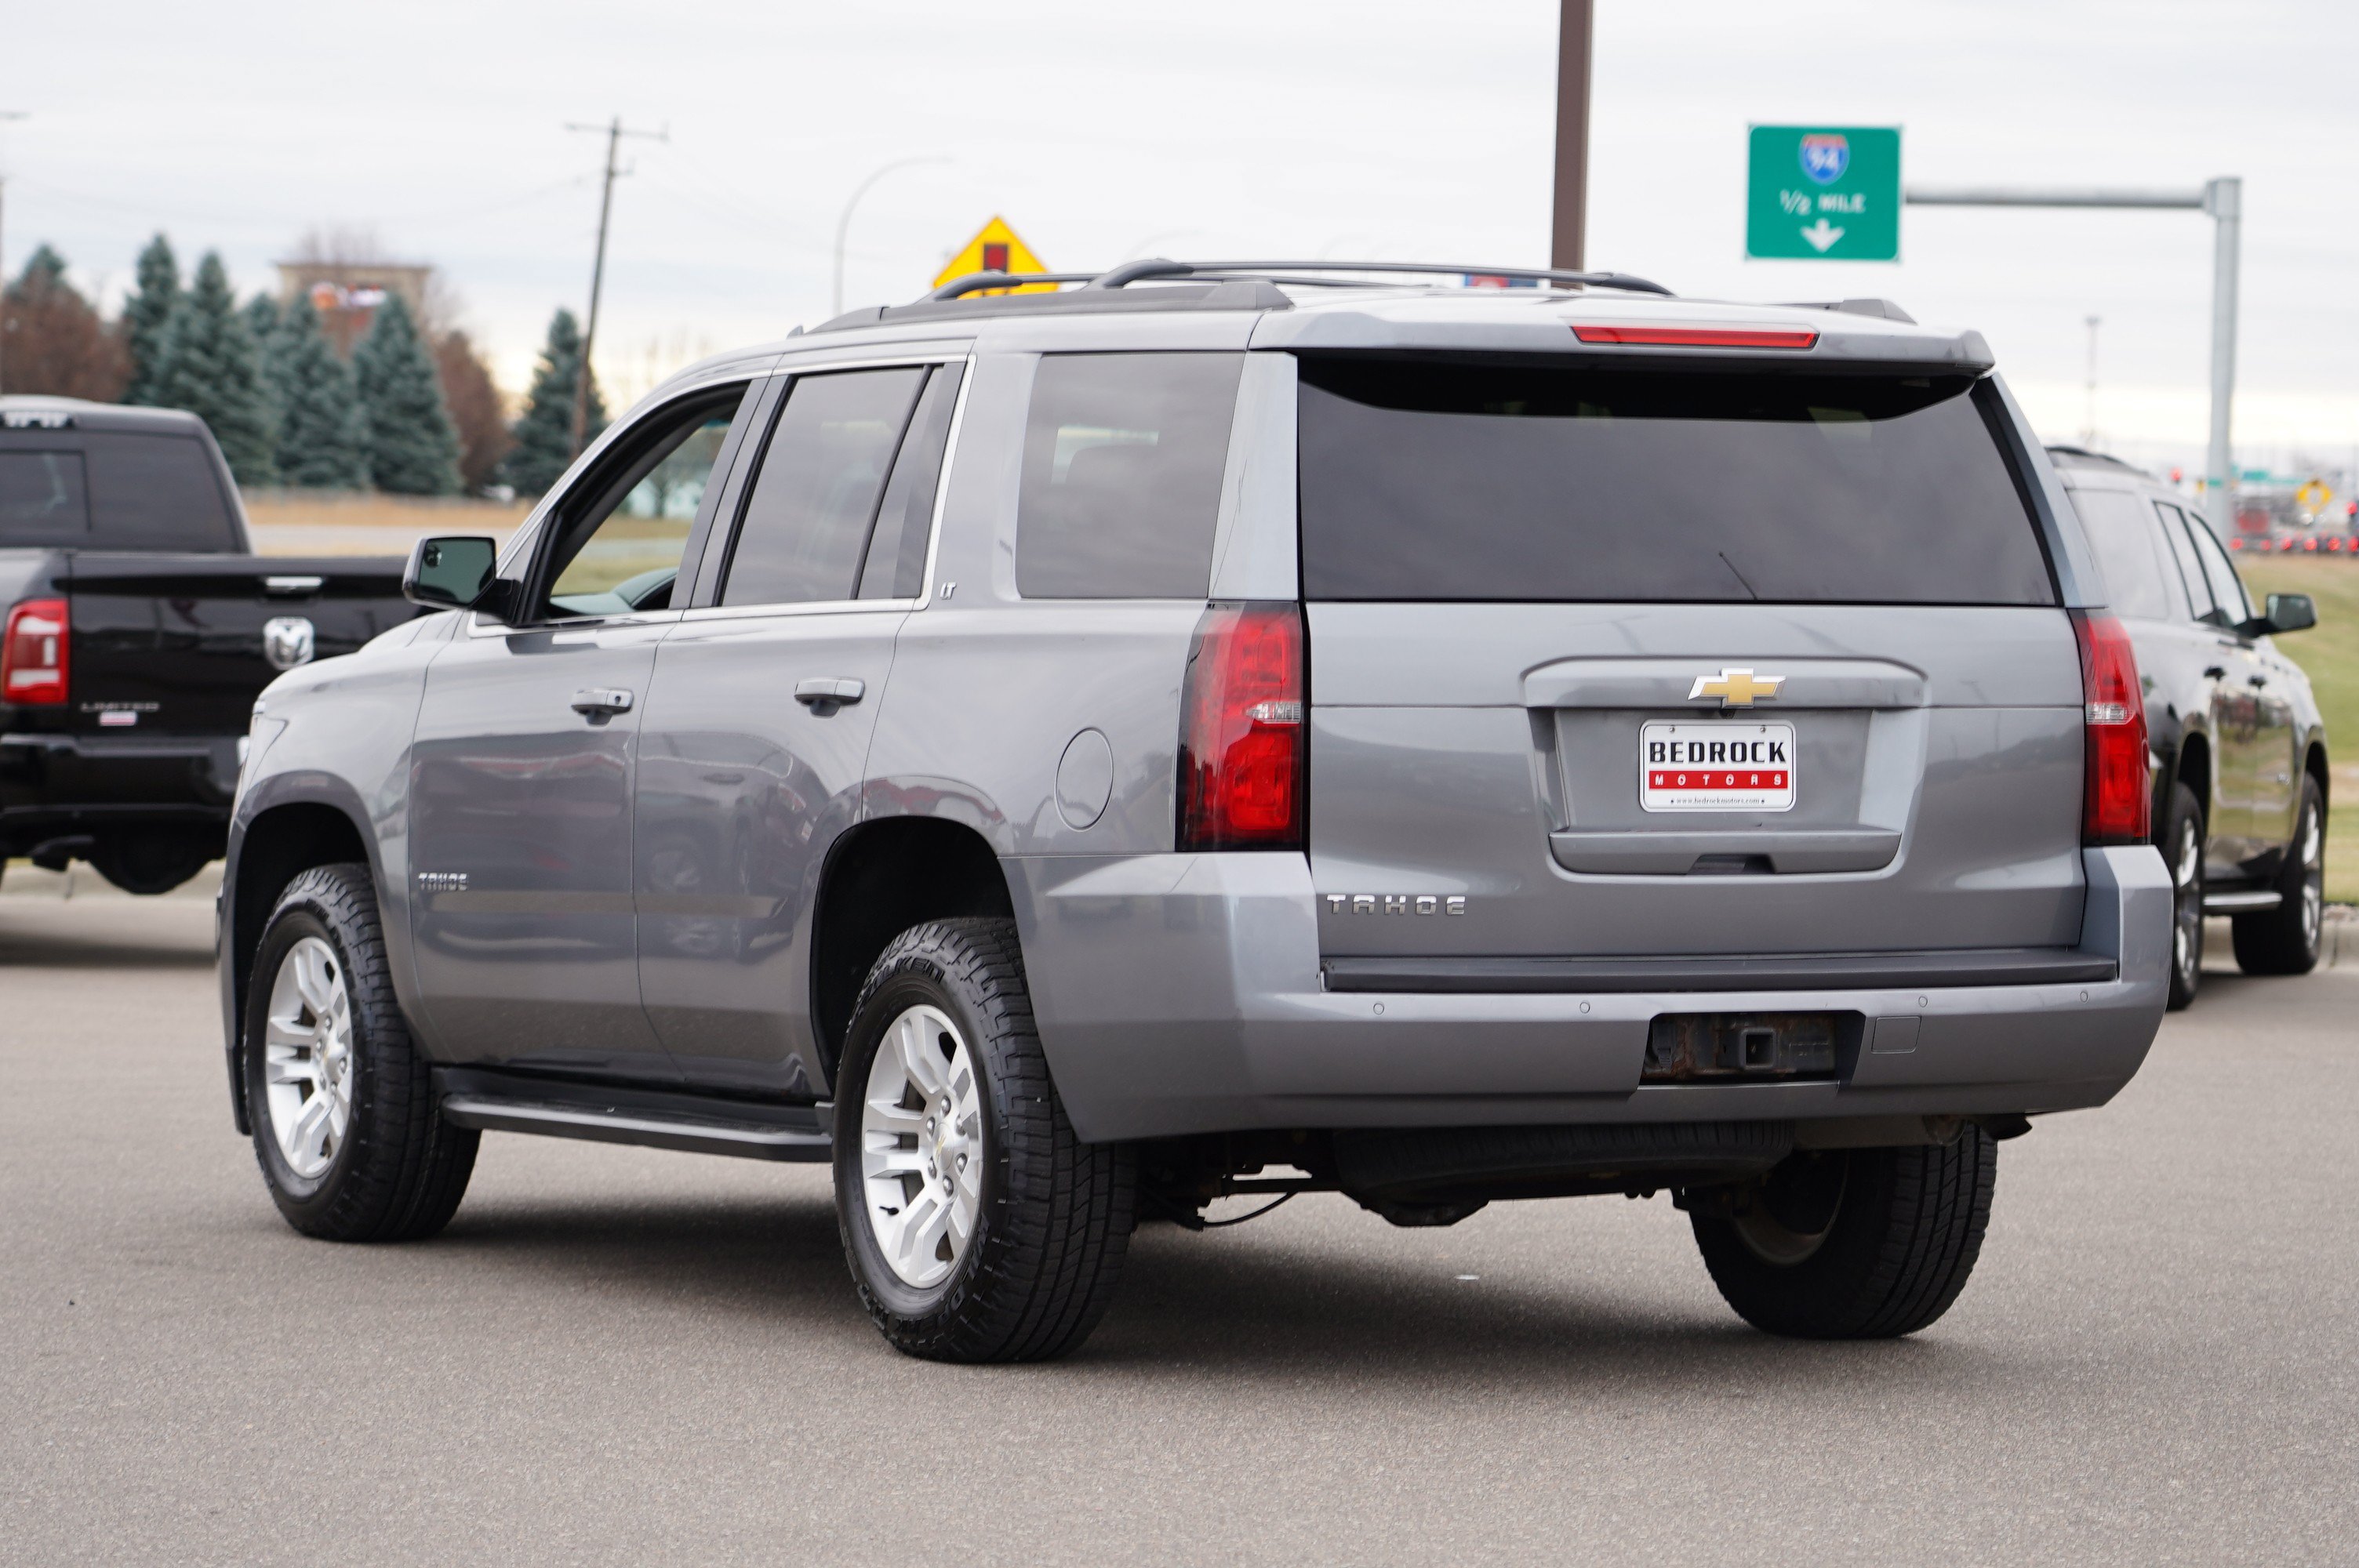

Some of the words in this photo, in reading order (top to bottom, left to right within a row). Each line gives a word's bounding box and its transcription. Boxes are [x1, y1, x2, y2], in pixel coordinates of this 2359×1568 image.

[1807, 147, 1838, 170] 94
[1818, 193, 1866, 214] MILE
[940, 583, 957, 601] LT
[1649, 742, 1786, 763] BEDROCK
[1655, 773, 1782, 786] MOTORS
[1676, 796, 1760, 805] www.bedrockmotors.com
[419, 872, 467, 891] TAHOE
[1326, 894, 1467, 916] TAHOE
